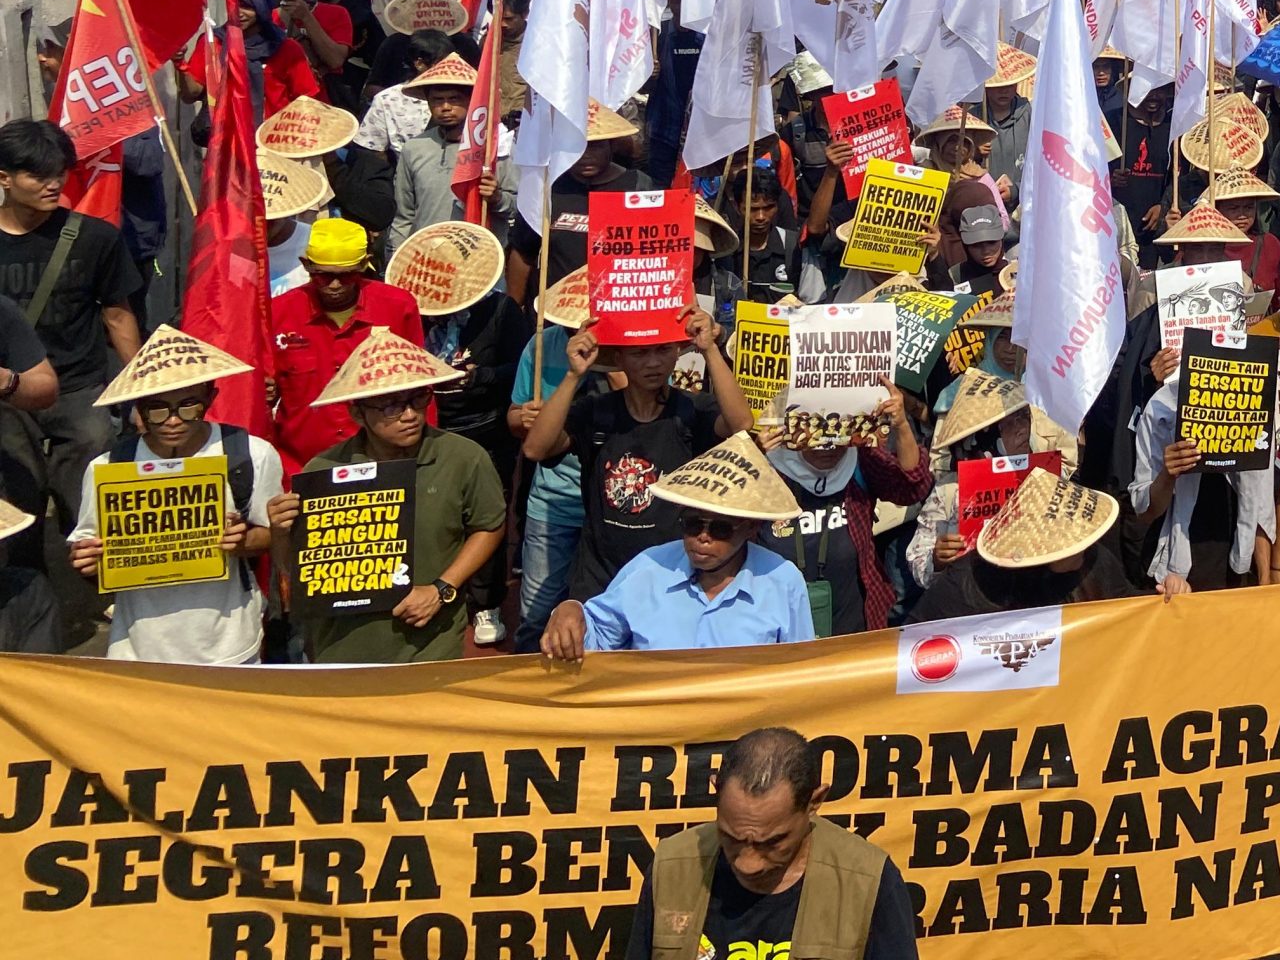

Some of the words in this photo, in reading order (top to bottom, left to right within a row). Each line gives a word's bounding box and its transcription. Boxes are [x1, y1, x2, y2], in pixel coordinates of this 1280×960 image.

[841, 115, 859, 128] SAY
[864, 109, 877, 122] NO
[880, 103, 892, 116] TO
[853, 126, 889, 145] PERKUAT
[1133, 162, 1153, 171] SPP
[865, 183, 938, 214] REFORMA
[860, 204, 932, 233] AGRARIA
[606, 226, 634, 240] SAY
[638, 225, 659, 239] NO
[664, 224, 680, 237] TO
[857, 224, 883, 236] FONDASI
[640, 237, 690, 255] ESTATE
[852, 240, 890, 254] BERBASIS
[614, 257, 668, 271] PERKUAT
[608, 270, 676, 284] PERTANIAN
[612, 285, 660, 298] RAKYAT
[911, 292, 950, 305] STOP
[596, 300, 647, 312] PANGAN
[650, 296, 684, 310] LOKAL
[885, 296, 946, 324] APARAT
[898, 307, 927, 324] TARIK
[1178, 317, 1194, 327] Atas
[1195, 315, 1217, 325] Tanah
[1218, 314, 1231, 323] dan
[917, 325, 940, 340] DARI
[796, 330, 891, 355] WUJUDKAN
[136, 346, 203, 368] UNTUK
[361, 352, 430, 369] UNTUK
[796, 355, 820, 372] HAK
[822, 355, 852, 372] ATAS
[854, 355, 891, 371] TANAH
[1191, 356, 1265, 375] BURUH-TANI
[358, 363, 438, 386] RAKYAT
[737, 376, 765, 389] FONDASI
[795, 372, 820, 389] BAGI
[1189, 372, 1264, 393] BERSATU
[1188, 389, 1263, 409] BANGUN
[1183, 406, 1268, 422] KEDAULATAN
[1181, 422, 1264, 440] EKONOMI
[667, 473, 730, 497] SEJATI
[105, 483, 219, 513] REFORMA
[307, 490, 400, 510] BURUH-TANI
[976, 491, 999, 504] SAY
[106, 504, 219, 537] AGRARIA
[306, 505, 400, 530] BERSATU
[307, 522, 399, 548] BANGUN
[302, 541, 405, 562] KEDAULATAN
[300, 556, 402, 582] EKONOMI
[307, 573, 393, 596] PANGAN
[990, 640, 1041, 664] KPA
[0, 745, 586, 834] JALANKAN
[610, 724, 1078, 811] REORMA
[24, 834, 441, 912] SEGERA
[908, 780, 1223, 869] BADAN
[207, 905, 638, 960] REFORM
